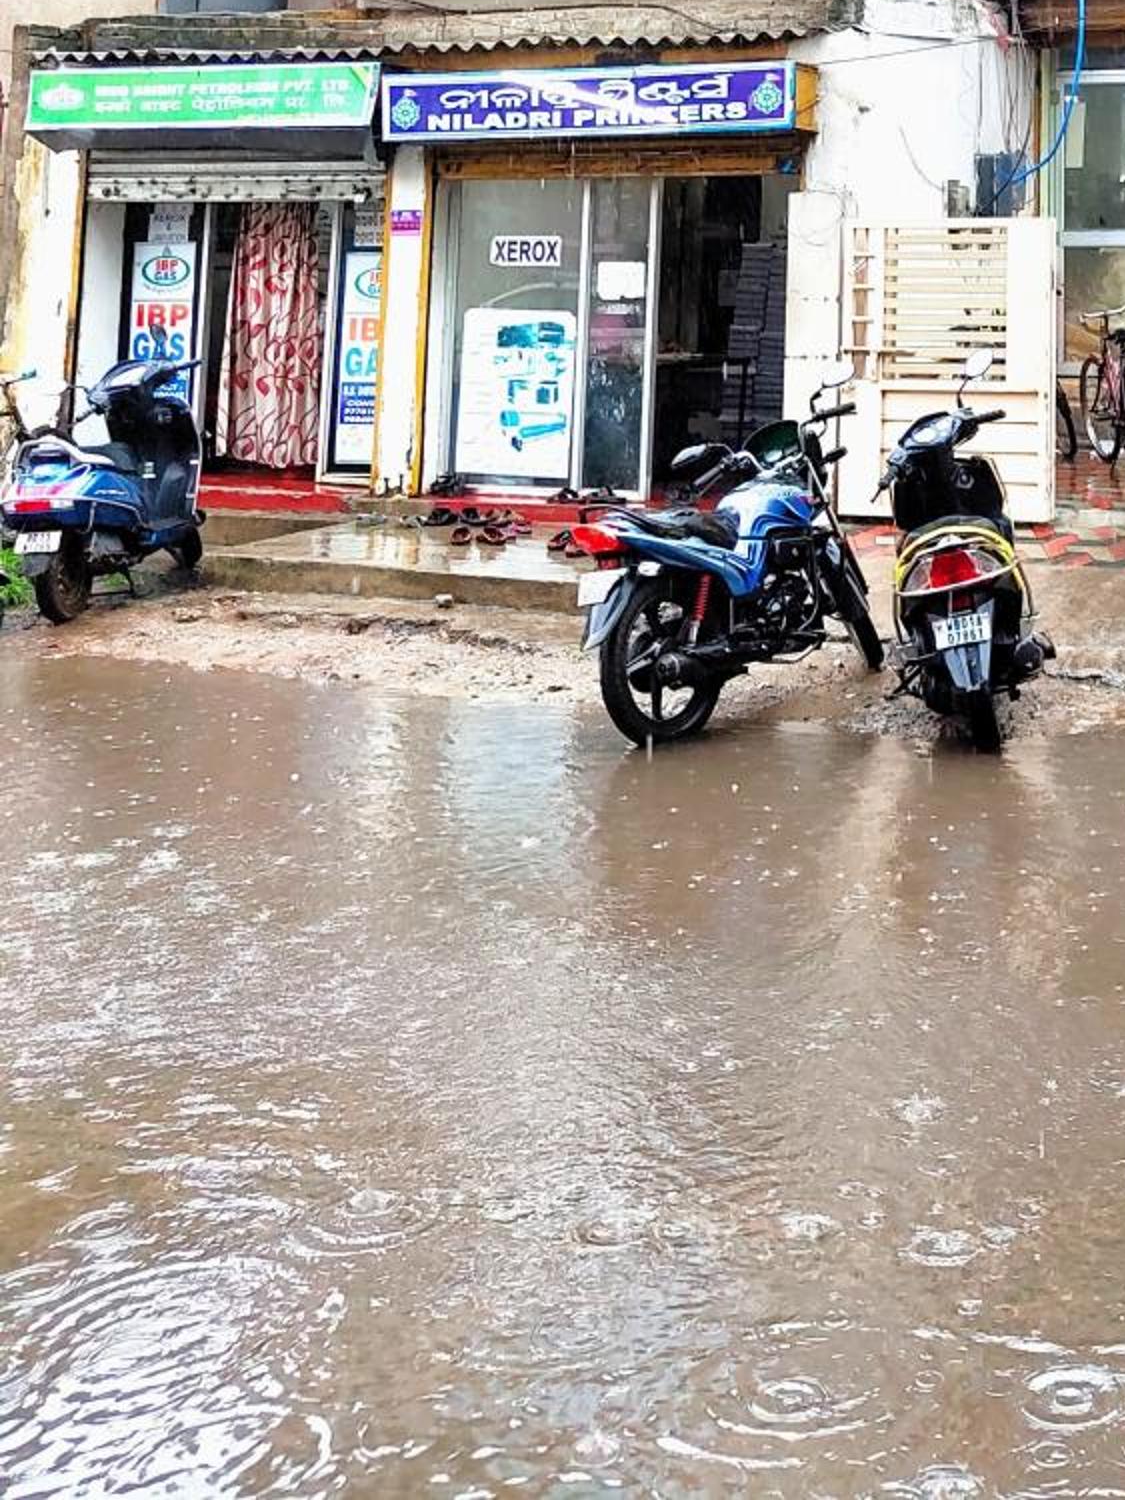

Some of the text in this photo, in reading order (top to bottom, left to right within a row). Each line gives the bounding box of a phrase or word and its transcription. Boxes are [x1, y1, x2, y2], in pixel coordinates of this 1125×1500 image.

[426, 110, 562, 131] NILADRI
[494, 239, 560, 264] XEROX
[154, 272, 178, 281] GAS
[155, 259, 179, 271] IBP
[136, 303, 189, 327] IBP
[349, 318, 380, 341] IB
[133, 332, 185, 362] GAS
[345, 347, 377, 377] GA
